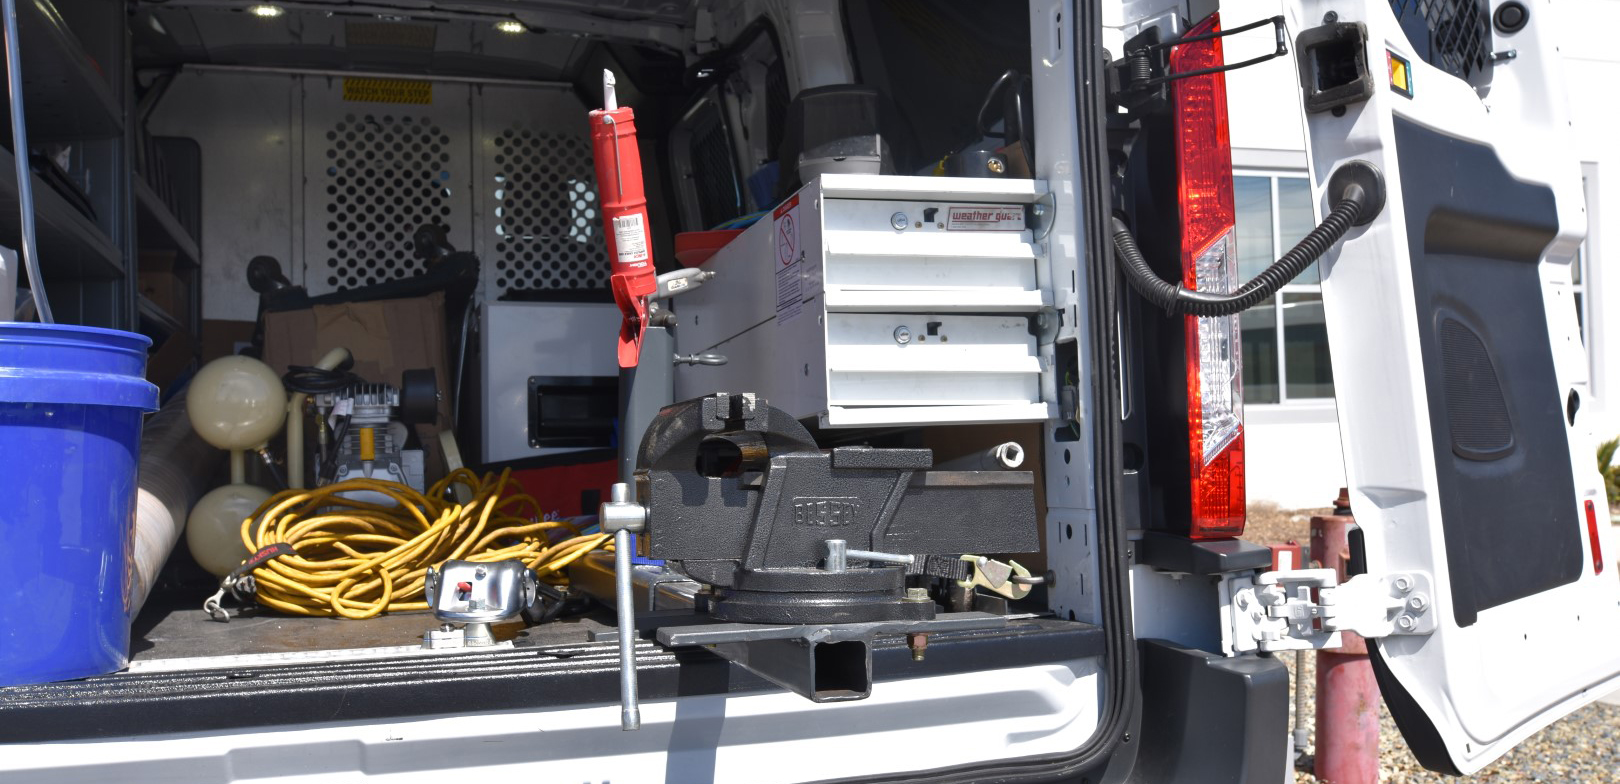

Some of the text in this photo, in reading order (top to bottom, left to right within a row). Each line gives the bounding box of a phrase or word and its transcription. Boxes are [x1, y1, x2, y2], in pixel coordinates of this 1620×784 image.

[346, 86, 430, 97] WATCH YOUR STEP
[952, 210, 993, 221] weather
